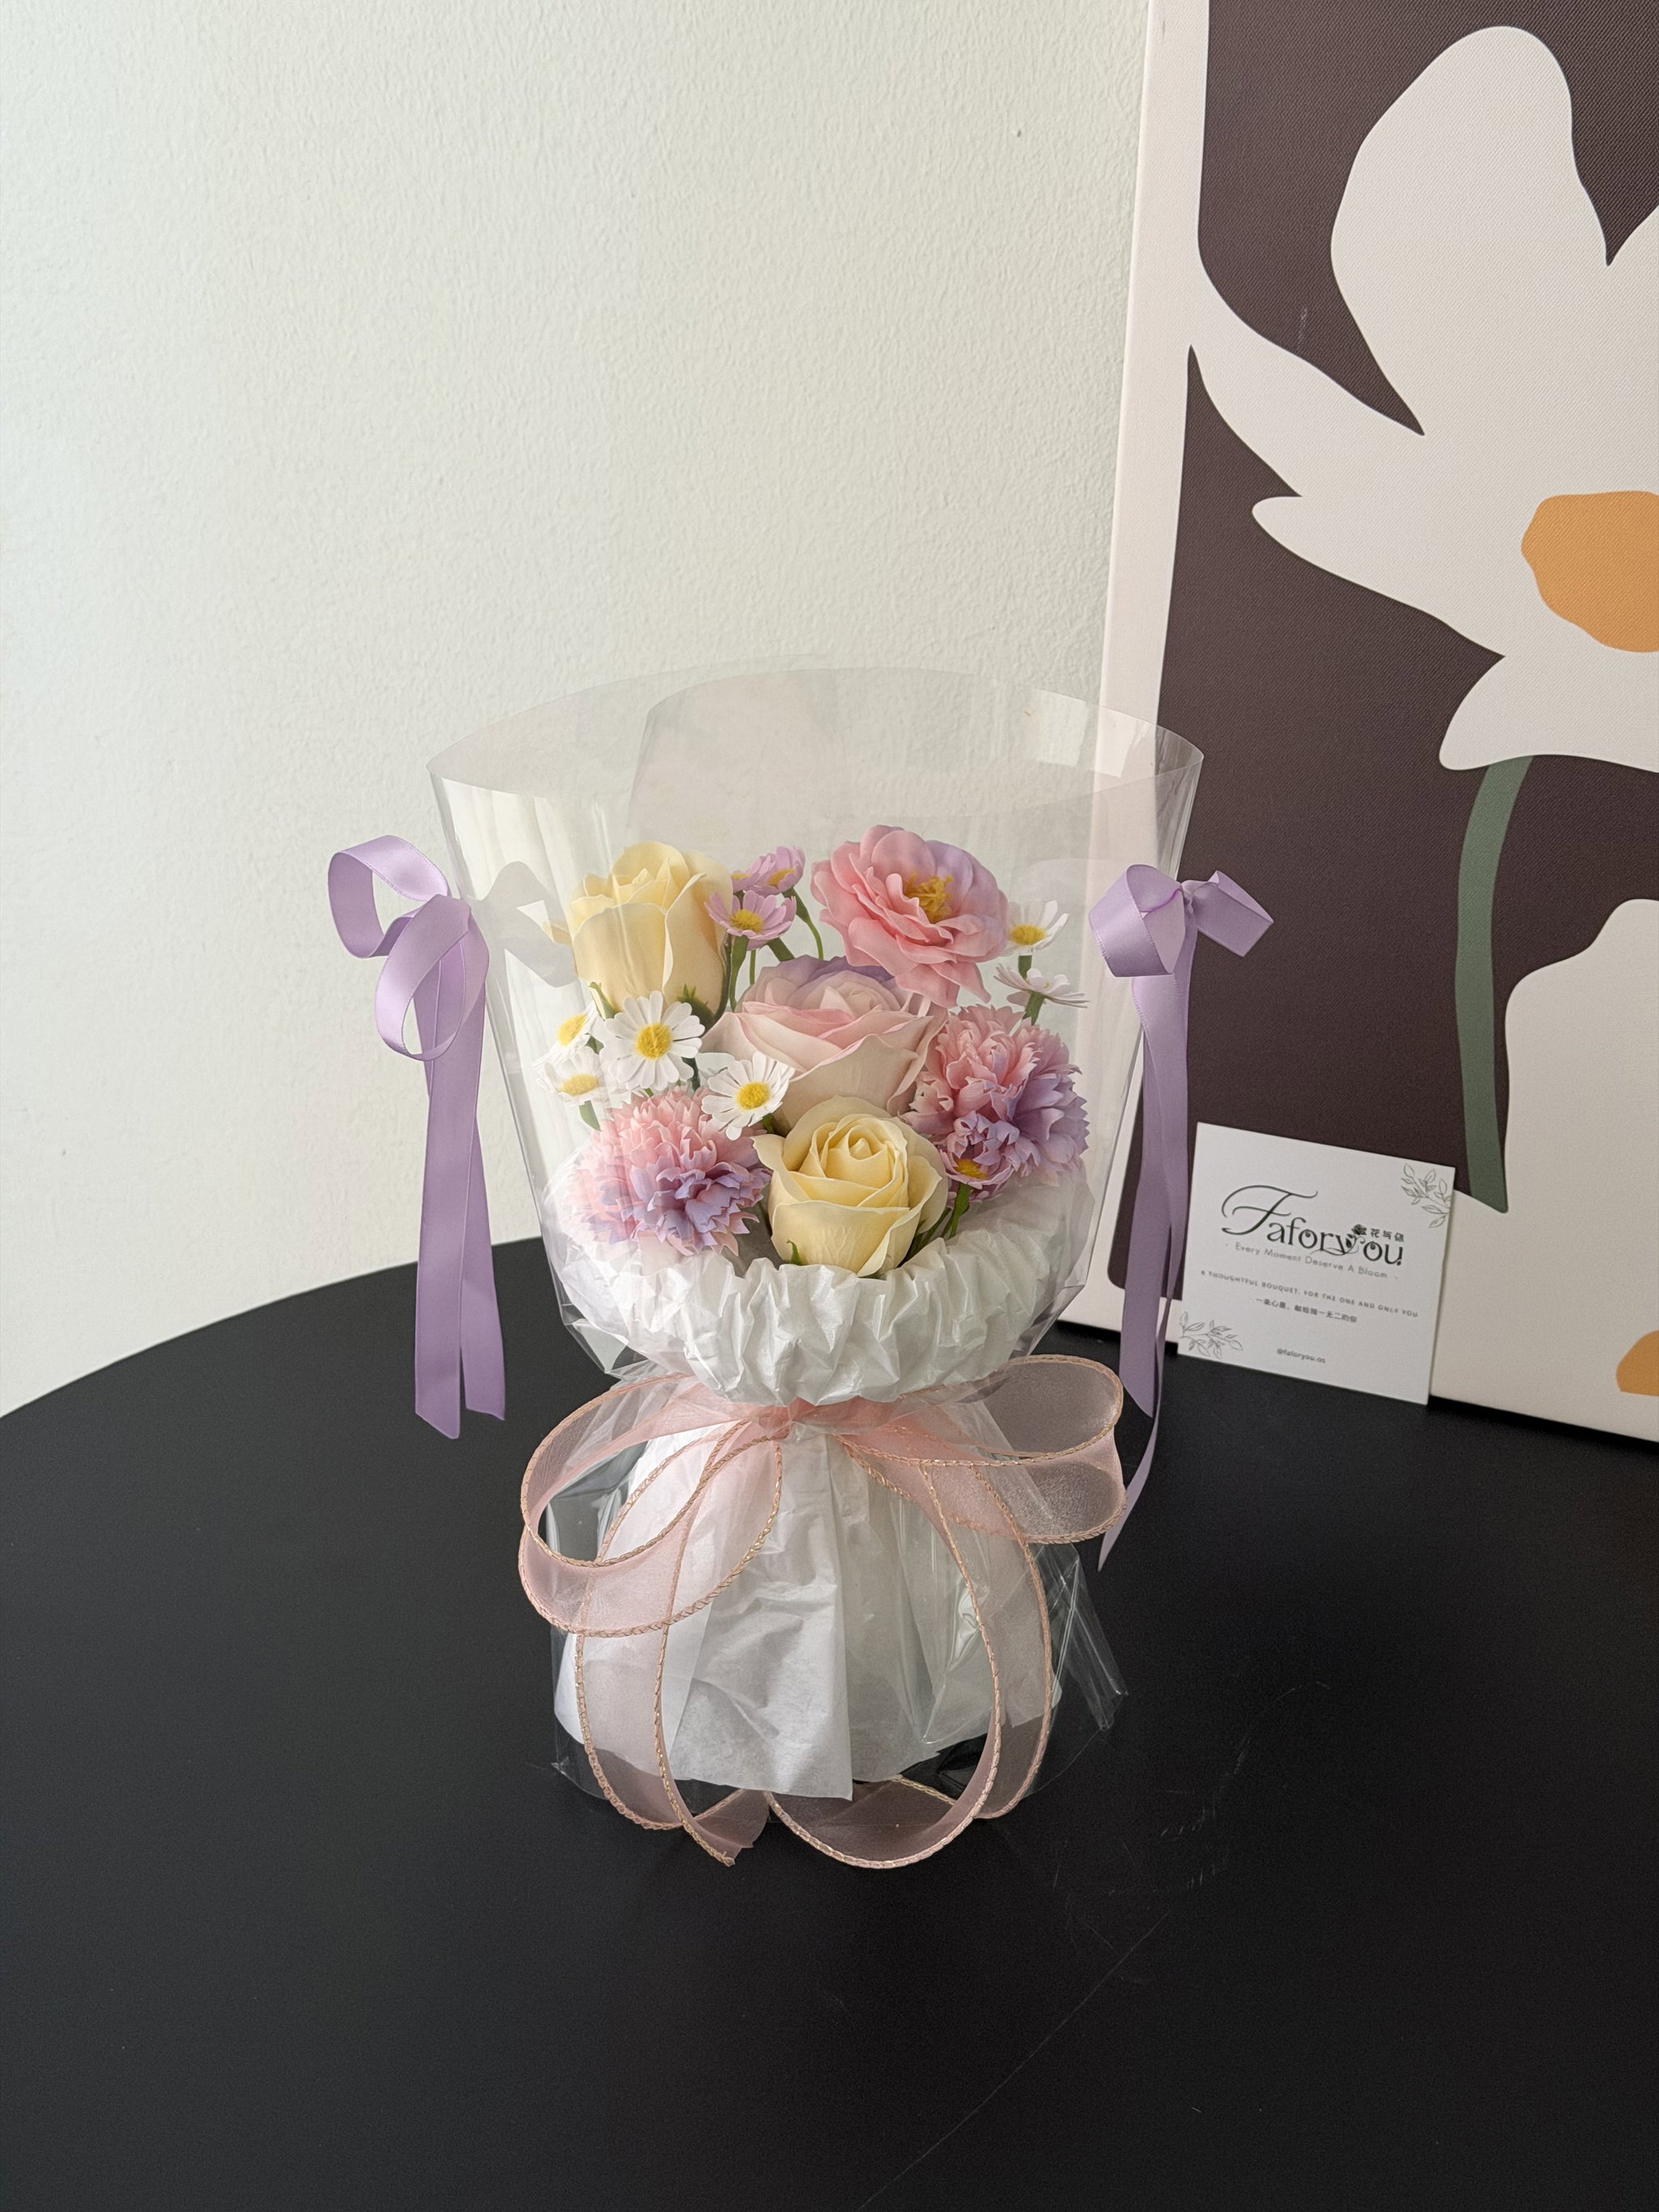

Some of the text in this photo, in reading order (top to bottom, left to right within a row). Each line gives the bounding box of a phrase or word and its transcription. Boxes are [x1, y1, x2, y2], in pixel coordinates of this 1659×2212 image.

[1235, 1242, 1388, 1278] Every Moment Deserve A Bloom
[1303, 1289, 1319, 1298] FOR
[1322, 1293, 1336, 1302] THE
[1339, 1297, 1355, 1306] ONE
[1358, 1301, 1375, 1309] AND
[1401, 1309, 1418, 1318] YOU
